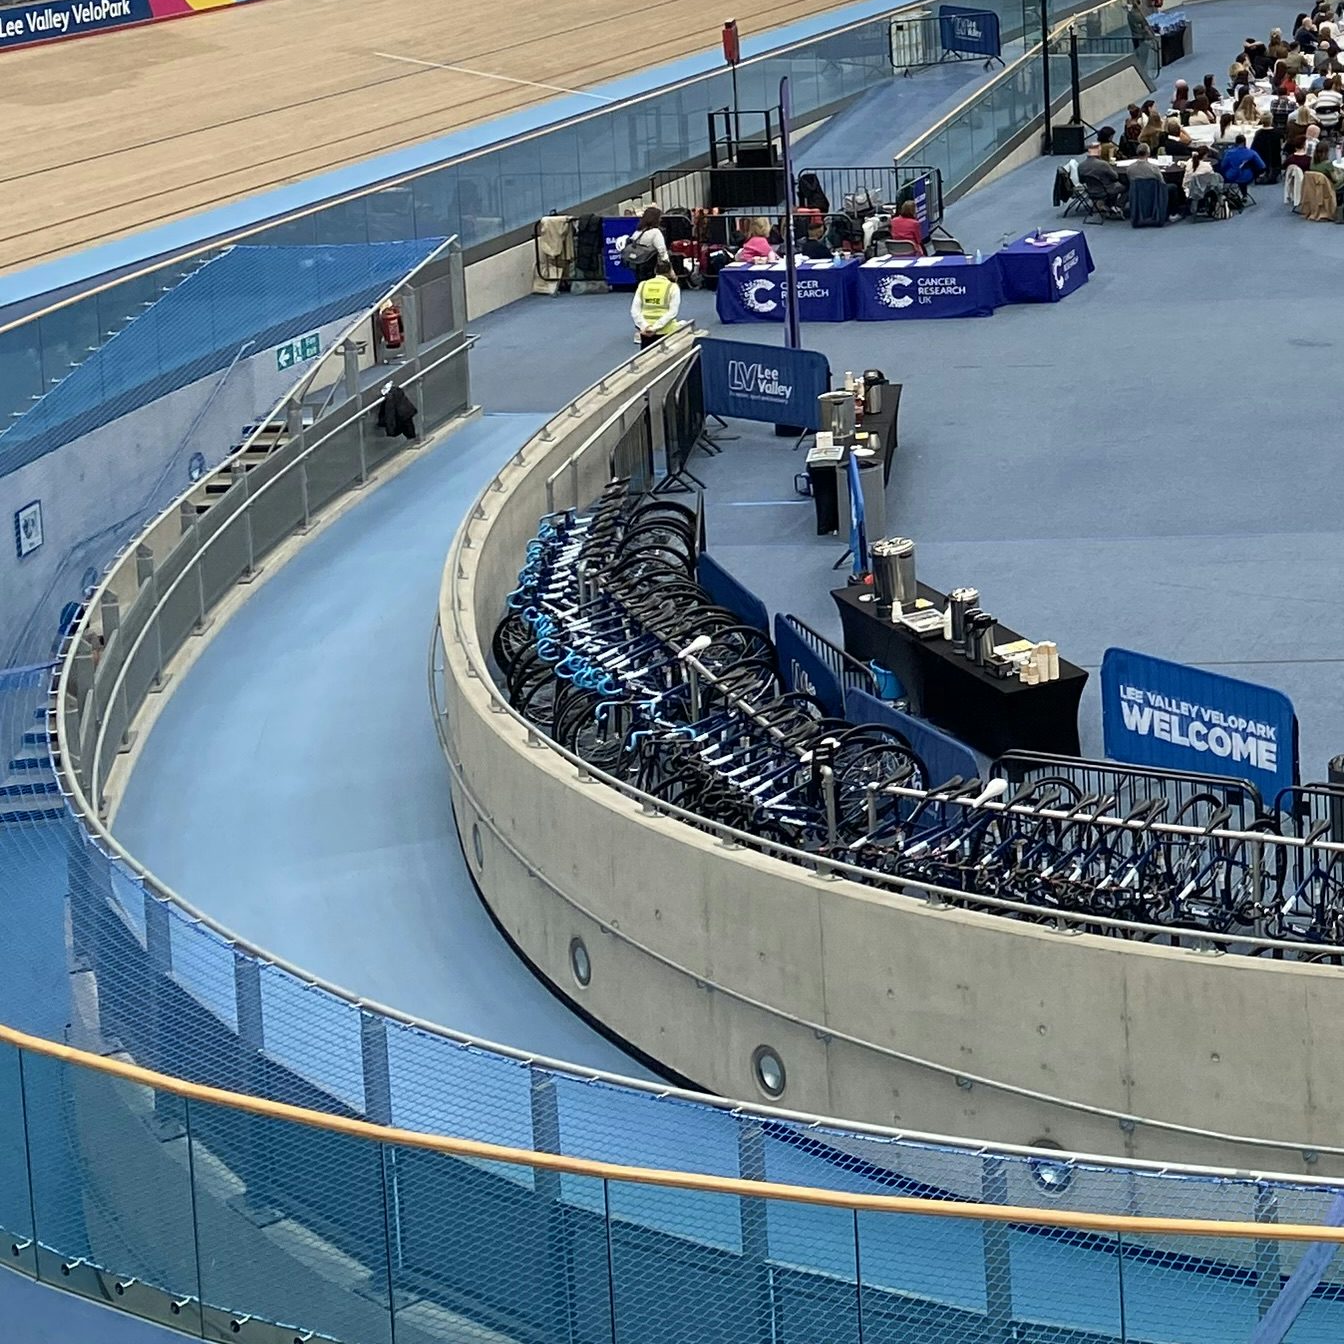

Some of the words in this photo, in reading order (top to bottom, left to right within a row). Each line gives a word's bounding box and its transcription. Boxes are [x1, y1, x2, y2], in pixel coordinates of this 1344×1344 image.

[0, 18, 24, 38] Lee
[27, 9, 70, 34] Valley
[918, 276, 957, 287] CANCER
[918, 286, 966, 297] RESEARCH
[918, 295, 932, 305] UK
[757, 363, 779, 380] Lee
[757, 378, 792, 399] Valley
[1119, 684, 1144, 703] LEE
[1147, 691, 1201, 718] VALLEY
[1200, 706, 1277, 741] VELOPARK
[1121, 701, 1277, 774] WELCOME
